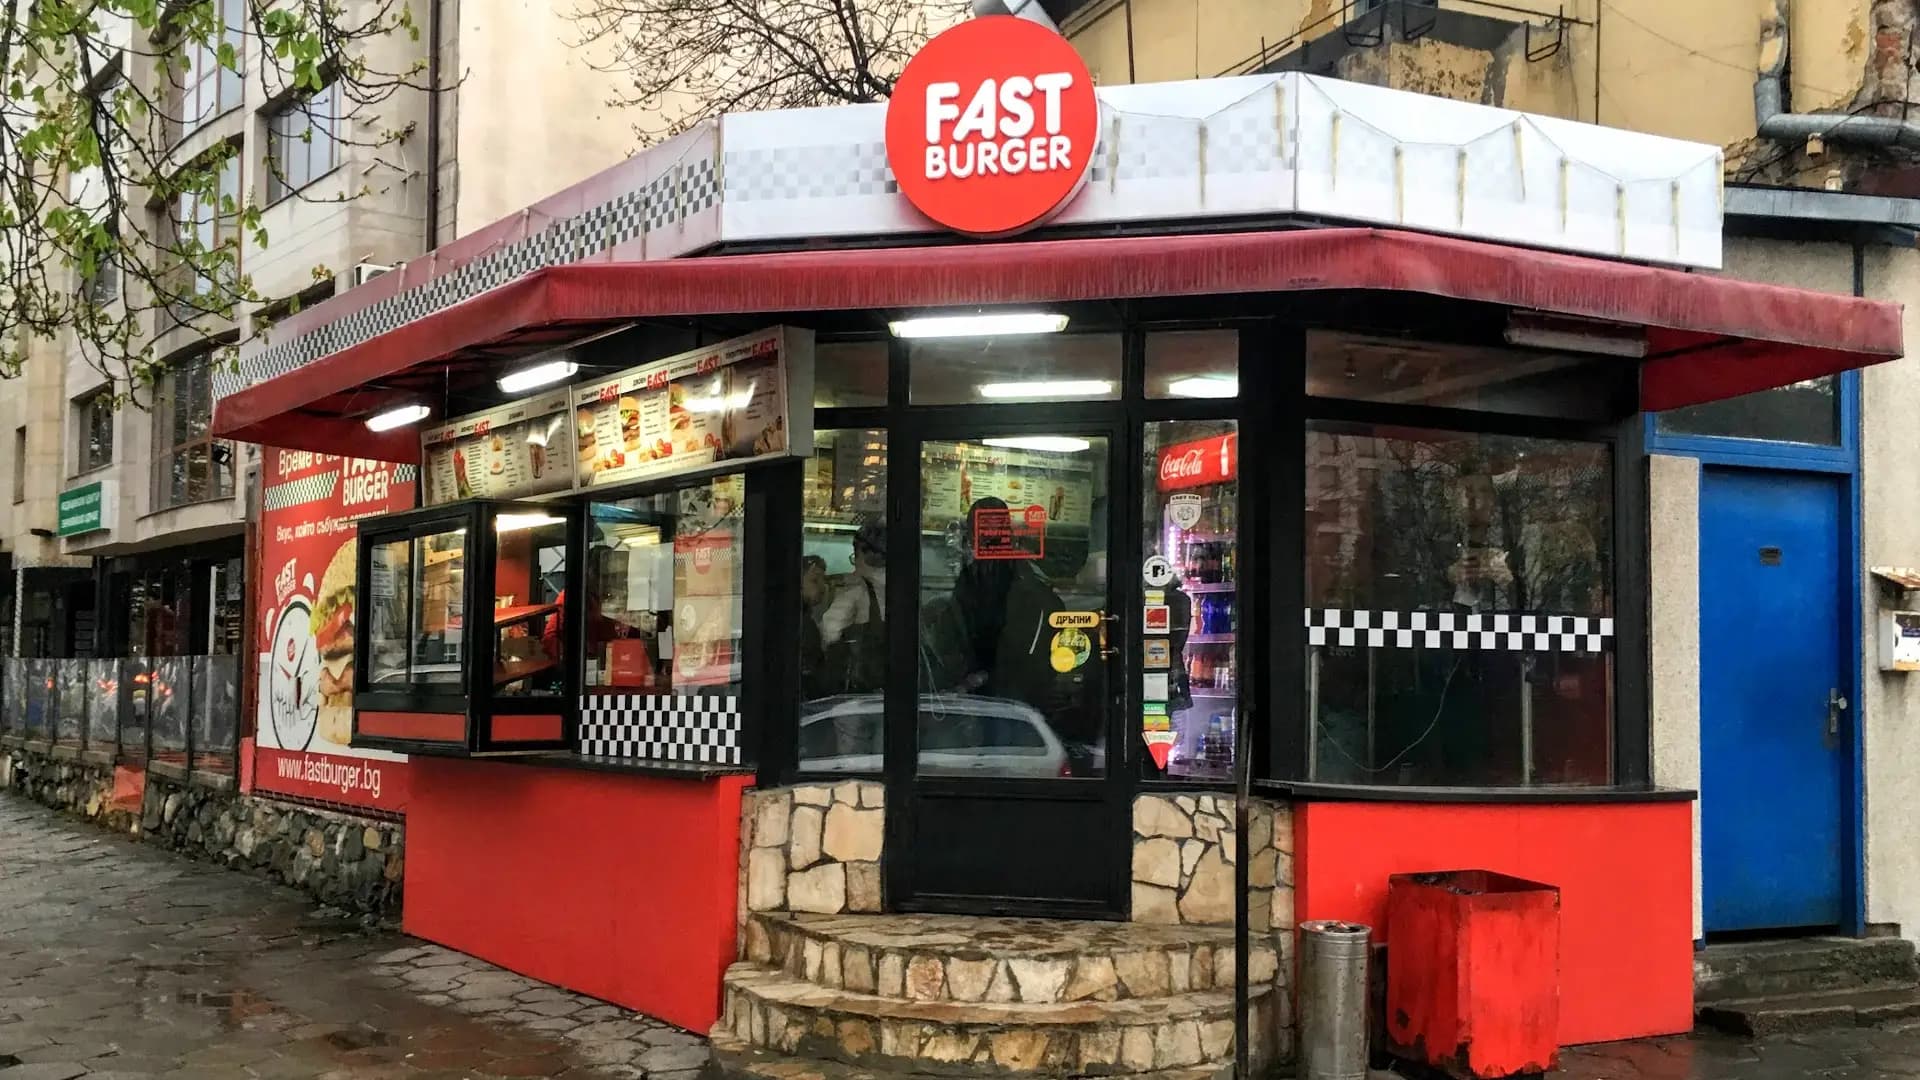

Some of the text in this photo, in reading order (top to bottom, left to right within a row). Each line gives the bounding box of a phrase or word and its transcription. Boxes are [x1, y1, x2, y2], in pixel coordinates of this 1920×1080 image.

[925, 71, 1074, 145] FAST
[925, 135, 1072, 180] BURGER
[342, 470, 389, 506] BURGER
[276, 526, 294, 544] Вкус,
[1056, 615, 1091, 625] ДРЪПНИ
[277, 754, 381, 799] www.fastburger.bg
